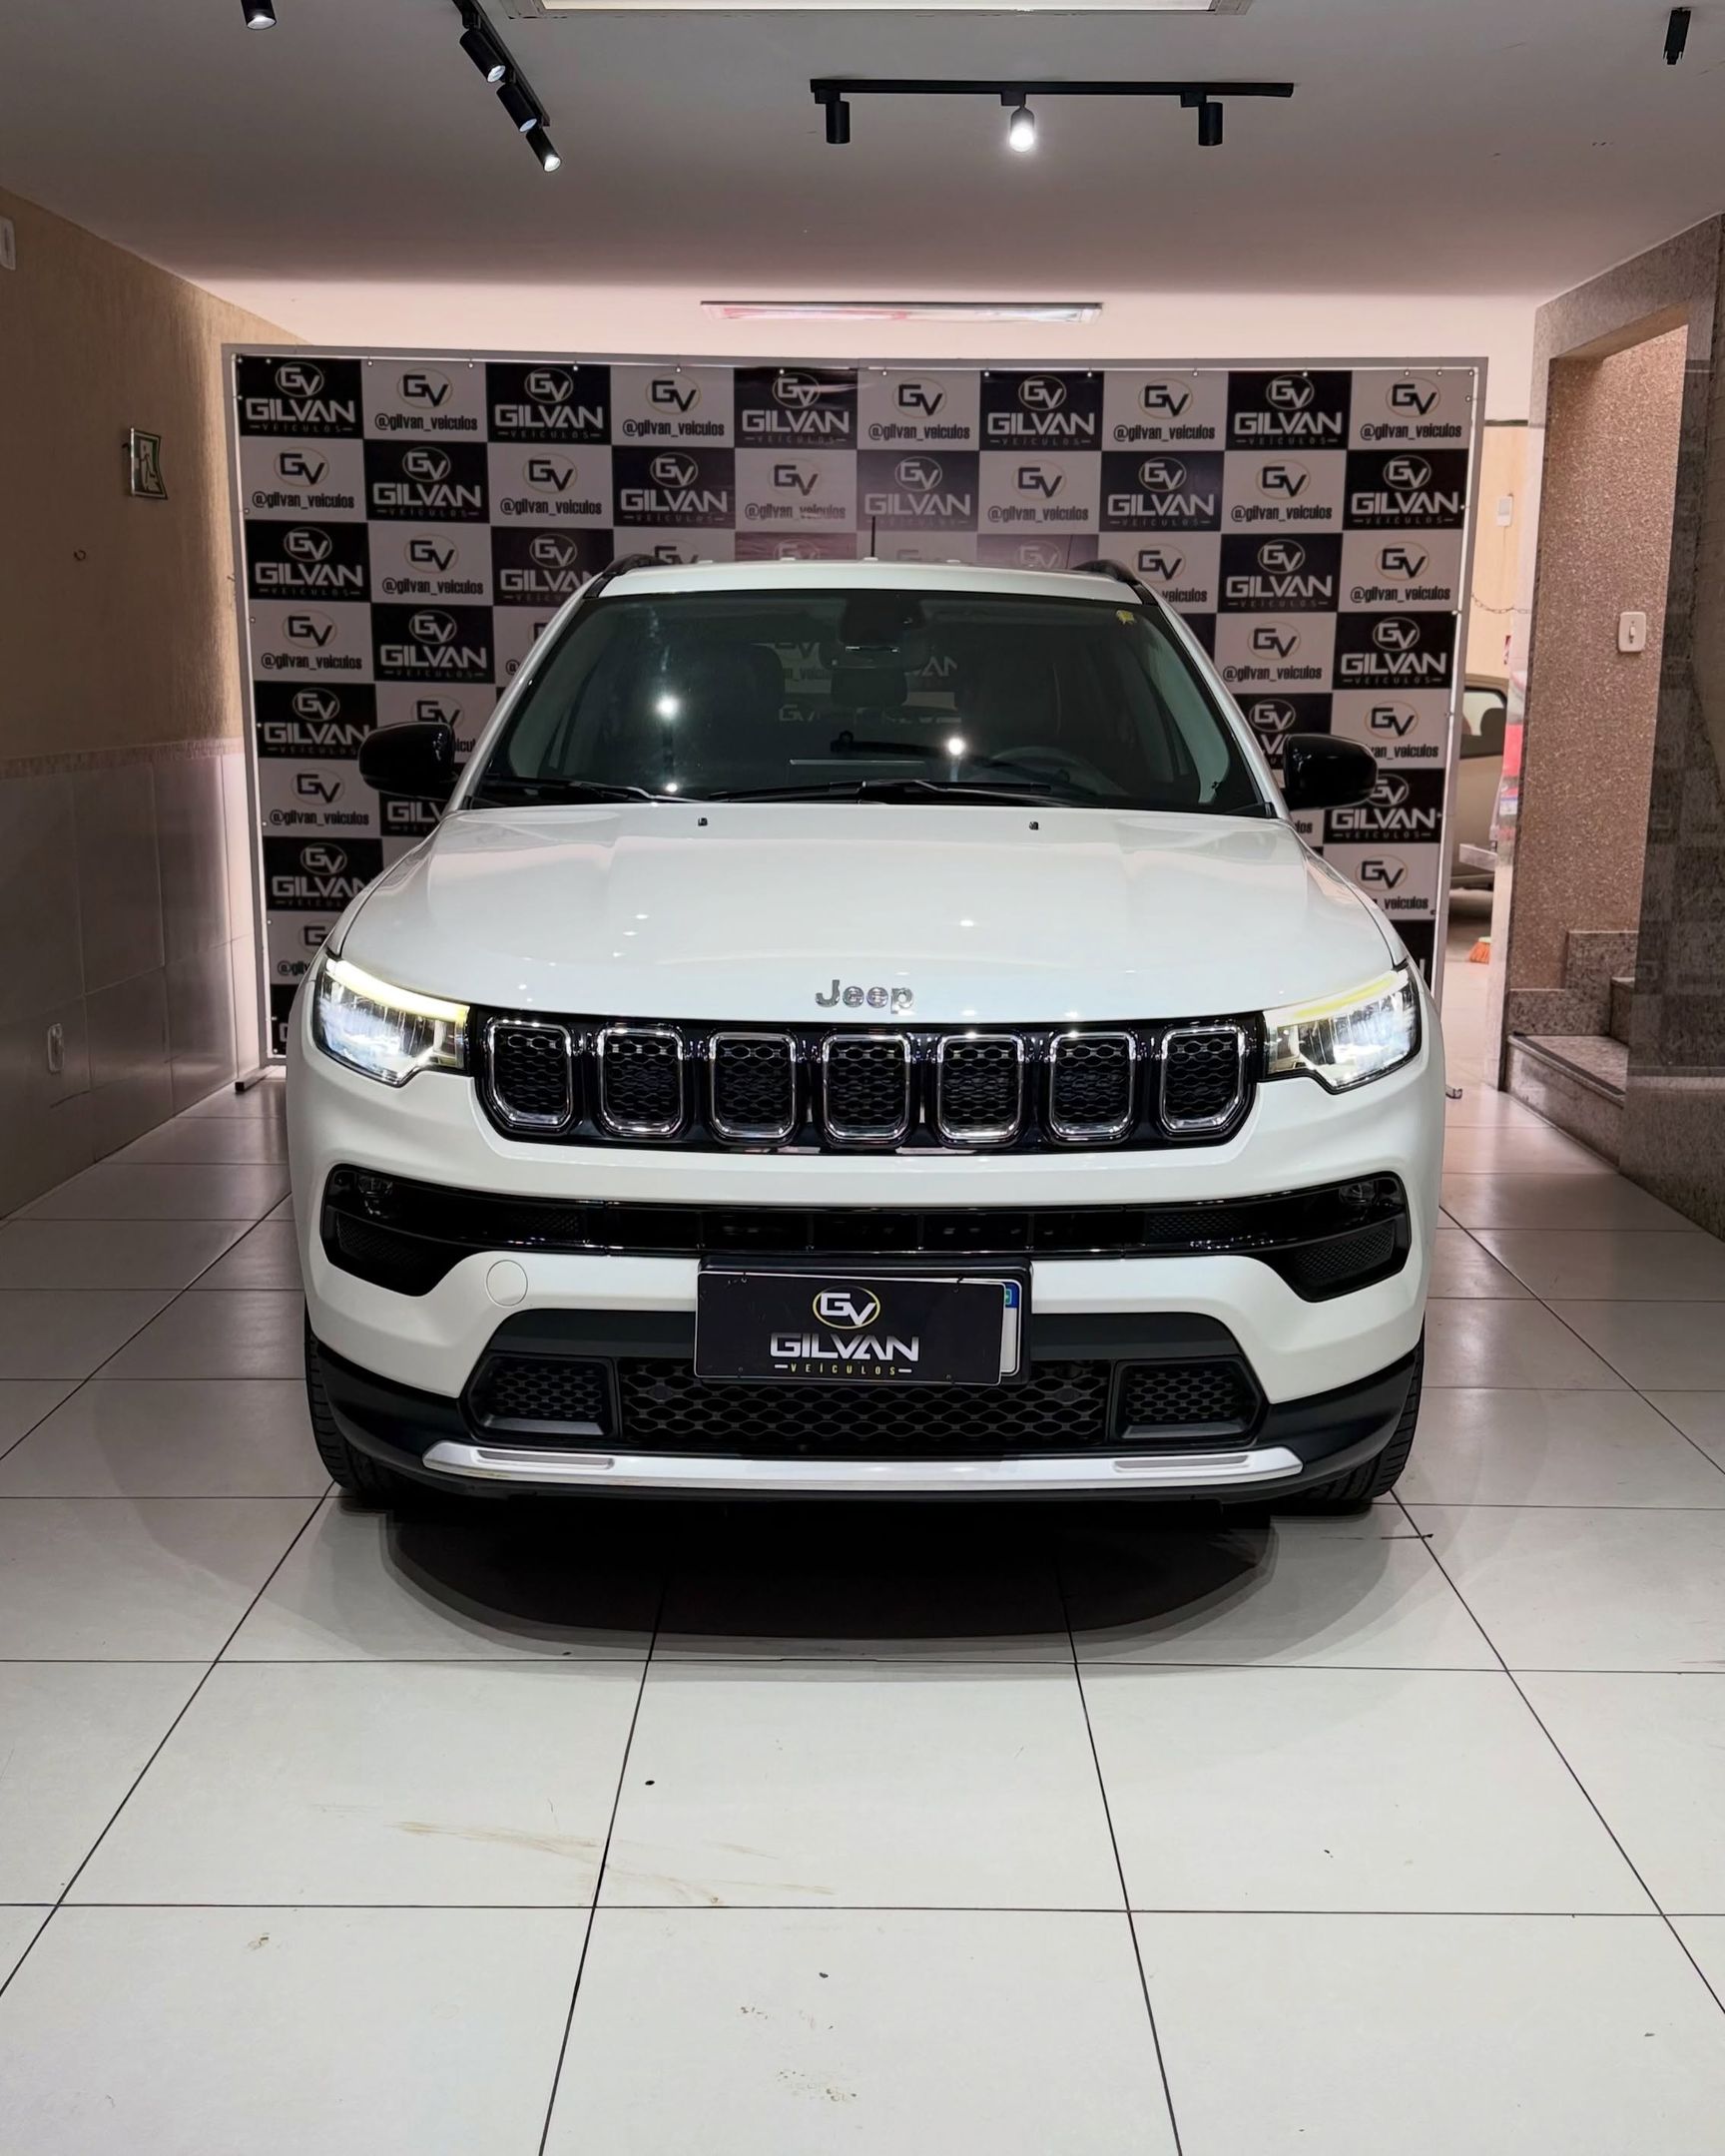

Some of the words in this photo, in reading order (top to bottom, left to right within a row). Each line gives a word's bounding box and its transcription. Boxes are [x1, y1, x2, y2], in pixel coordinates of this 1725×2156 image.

[280, 365, 319, 395] GV
[403, 375, 447, 406] GV
[529, 372, 569, 401] GV
[778, 377, 817, 406] GV
[1272, 379, 1312, 407] GV
[652, 380, 696, 412] GV
[898, 384, 942, 415] GV
[1023, 379, 1062, 409] GV
[1145, 385, 1188, 416] GV
[1393, 384, 1436, 415] GV
[246, 398, 355, 422] GILVAN
[375, 413, 477, 431] @gilvan_veiculos
[494, 405, 604, 428] GILVAN
[742, 410, 850, 433] GILVAN
[987, 413, 1095, 434] GILVAN
[1234, 412, 1343, 434] GILVAN
[623, 419, 724, 437] @gilvan_veiculos
[868, 423, 969, 441] @gilvan_veiculos
[1114, 424, 1215, 442] @gilvan_veiculos
[1361, 423, 1461, 440] @gilvan_veiculos
[281, 453, 324, 484] GV
[406, 451, 445, 480] GV
[529, 460, 572, 491] GV
[655, 457, 694, 487] GV
[899, 461, 938, 489] GV
[1144, 462, 1183, 490] GV
[1389, 461, 1428, 488] GV
[775, 465, 818, 495] GV
[1018, 467, 1062, 498] GV
[1263, 467, 1306, 497] GV
[253, 491, 354, 509] @gilvan_veiculos
[372, 483, 481, 507] GILVAN
[500, 498, 602, 516] @gilvan_veiculos
[620, 489, 728, 513] GILVAN
[863, 493, 970, 515] GILVAN
[1107, 494, 1215, 516] GILVAN
[1351, 491, 1458, 515] GILVAN
[988, 506, 1088, 523] @gilvan_veiculos
[1231, 505, 1332, 522] @gilvan_veiculos
[289, 532, 327, 560] GV
[410, 540, 454, 571] GV
[533, 537, 572, 566] GV
[1264, 545, 1302, 572] GV
[255, 563, 363, 586] GILVAN
[1138, 550, 1182, 580] GV
[1382, 548, 1426, 578] GV
[382, 577, 483, 596] @gilvan_veiculos
[1226, 576, 1333, 597] GILVAN
[1351, 586, 1450, 603] @gilvan_veiculos
[288, 616, 331, 647] GV
[414, 615, 453, 643] GV
[1378, 621, 1416, 649] GV
[380, 645, 487, 668] GILVAN
[1254, 628, 1296, 658] GV
[262, 653, 362, 670] @gilvan_veiculos
[1223, 666, 1322, 682] @gilvan_veiculos
[1341, 653, 1446, 674] GILVAN
[296, 692, 334, 720] GV
[1255, 704, 1293, 730] GV
[263, 721, 369, 746] GILVAN
[1372, 708, 1414, 737] GV
[297, 774, 339, 803] GV
[270, 809, 369, 826] @gilvan_veiculos
[387, 802, 447, 822] GILV
[1331, 808, 1436, 828] GILVAN
[304, 847, 342, 873] GV
[1362, 861, 1403, 888] GV
[1384, 896, 1429, 910] veiculos
[816, 979, 914, 1014] Jeep
[820, 1293, 876, 1326] GV
[770, 1333, 919, 1361] GILVAN
